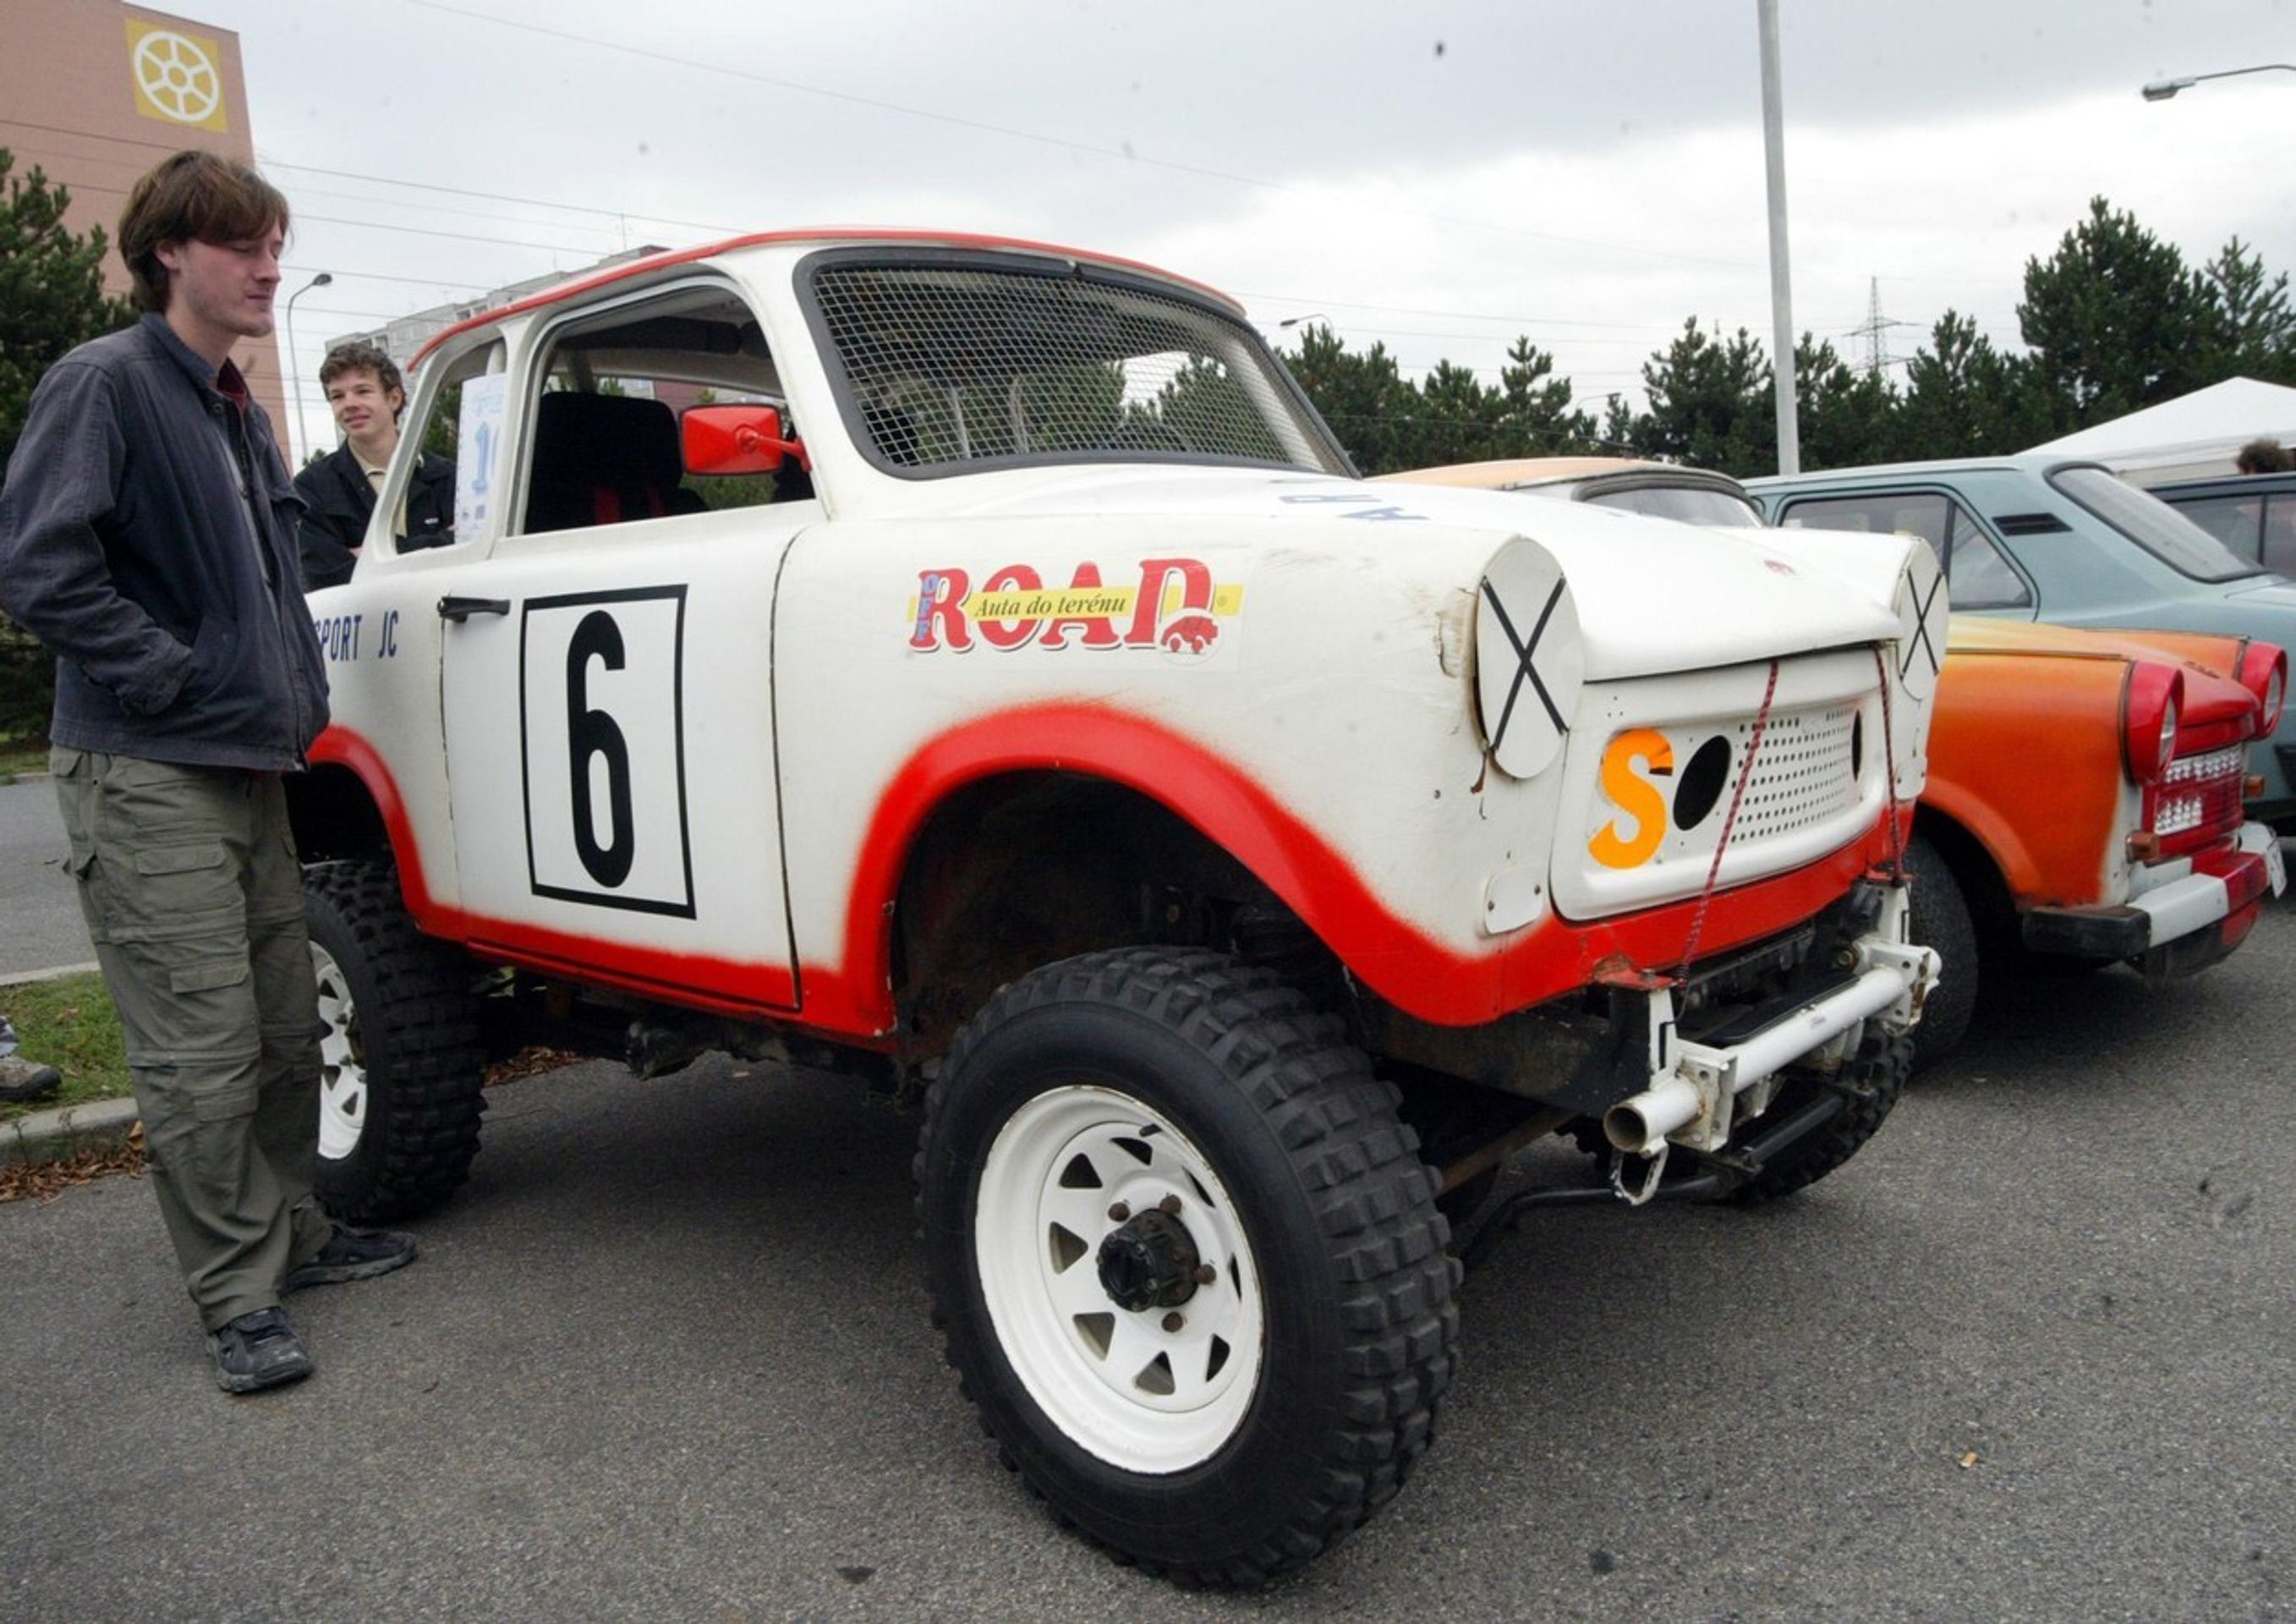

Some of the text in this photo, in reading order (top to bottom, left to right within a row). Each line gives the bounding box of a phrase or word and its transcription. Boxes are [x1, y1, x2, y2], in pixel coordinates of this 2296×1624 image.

[378, 610, 399, 659] JC
[908, 557, 1213, 652] ROAD
[974, 592, 1126, 617] Auta do terénu
[567, 609, 635, 888] 6
[1586, 727, 1674, 870] S
